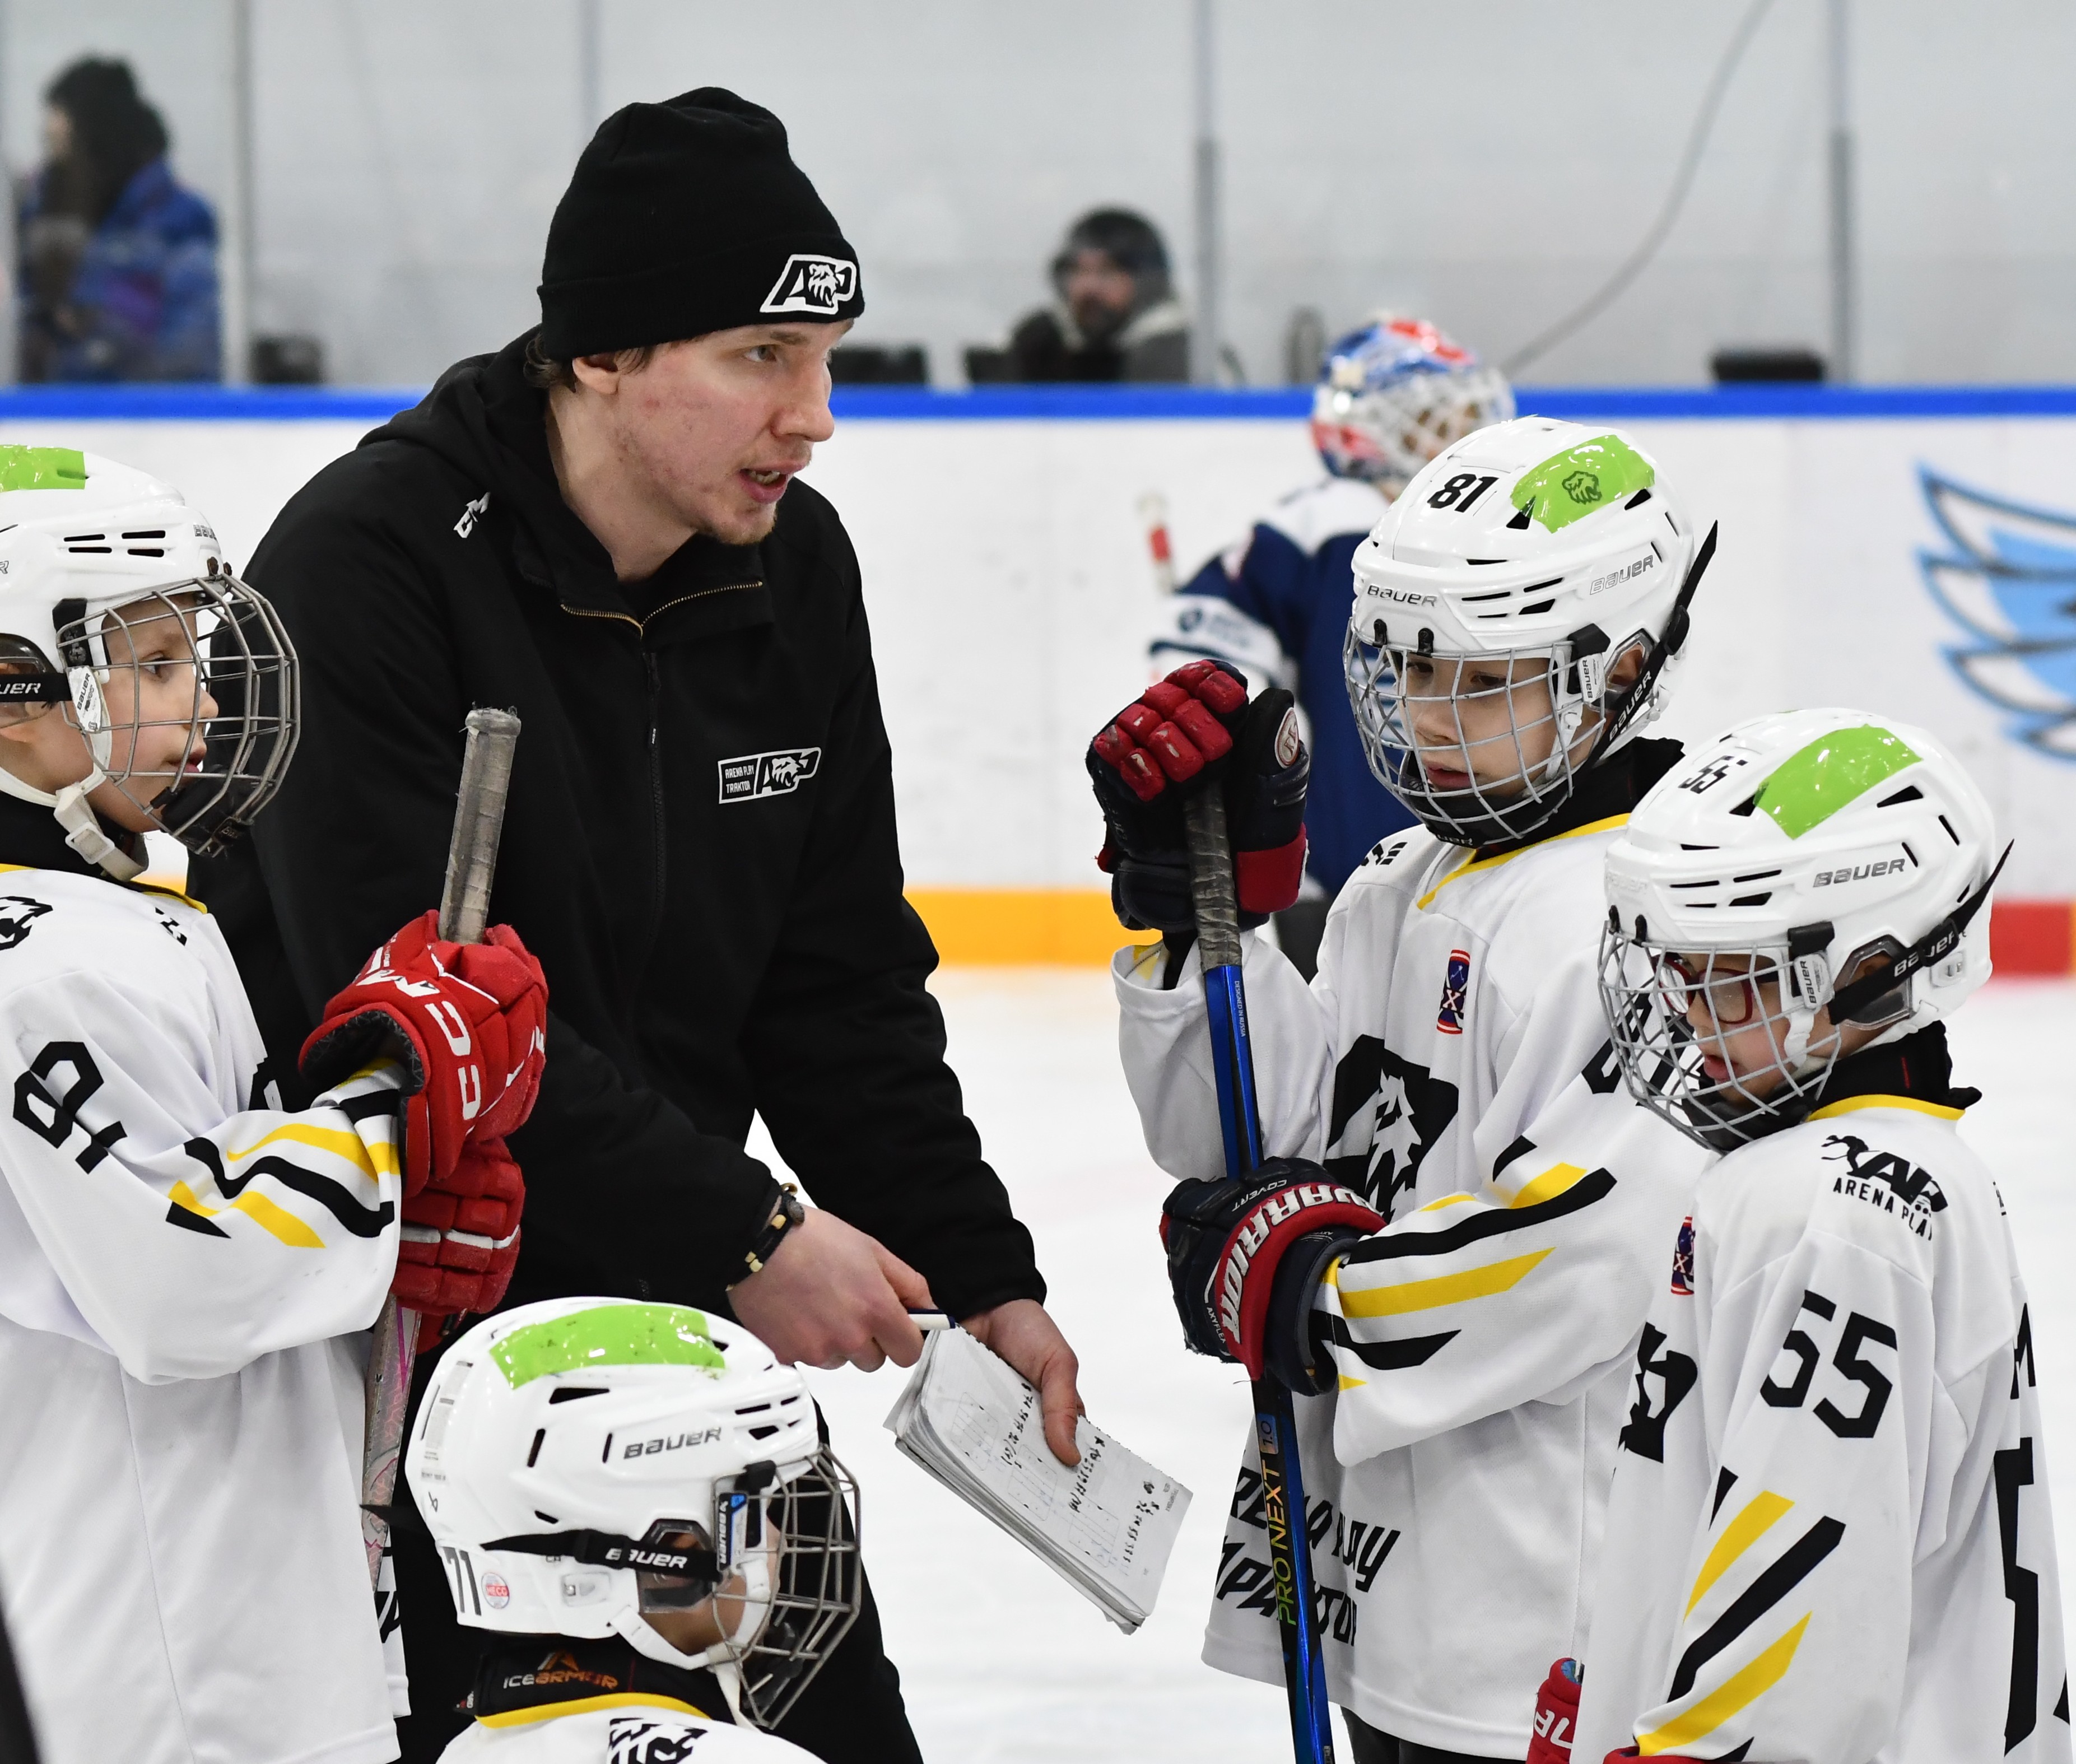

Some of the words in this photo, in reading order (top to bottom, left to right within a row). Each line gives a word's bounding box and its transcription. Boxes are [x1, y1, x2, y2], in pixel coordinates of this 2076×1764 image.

[1427, 473, 1499, 513] 81
[1590, 555, 1654, 595] BAUER
[1367, 584, 1438, 608] BAUER
[77, 672, 91, 711] BAUER
[1582, 659, 1593, 699] BAUER
[1609, 670, 1653, 742] BAUER
[725, 767, 743, 779] ARENA
[743, 764, 754, 776] PLAY
[726, 780, 751, 794] TRAKTOR
[1681, 755, 1748, 794] 55
[1813, 857, 1906, 888] BAUER
[1798, 960, 1817, 1004] BAUER
[1232, 1179, 1287, 1212] COVERT
[1833, 1177, 1895, 1213] ARENA
[1760, 1290, 1898, 1439] 55
[624, 1427, 723, 1461] BAUER
[1262, 1459, 1289, 1551] NEXT
[719, 1514, 728, 1565] BAUER
[442, 1546, 482, 1616] 71
[1277, 1557, 1297, 1626] PRO
